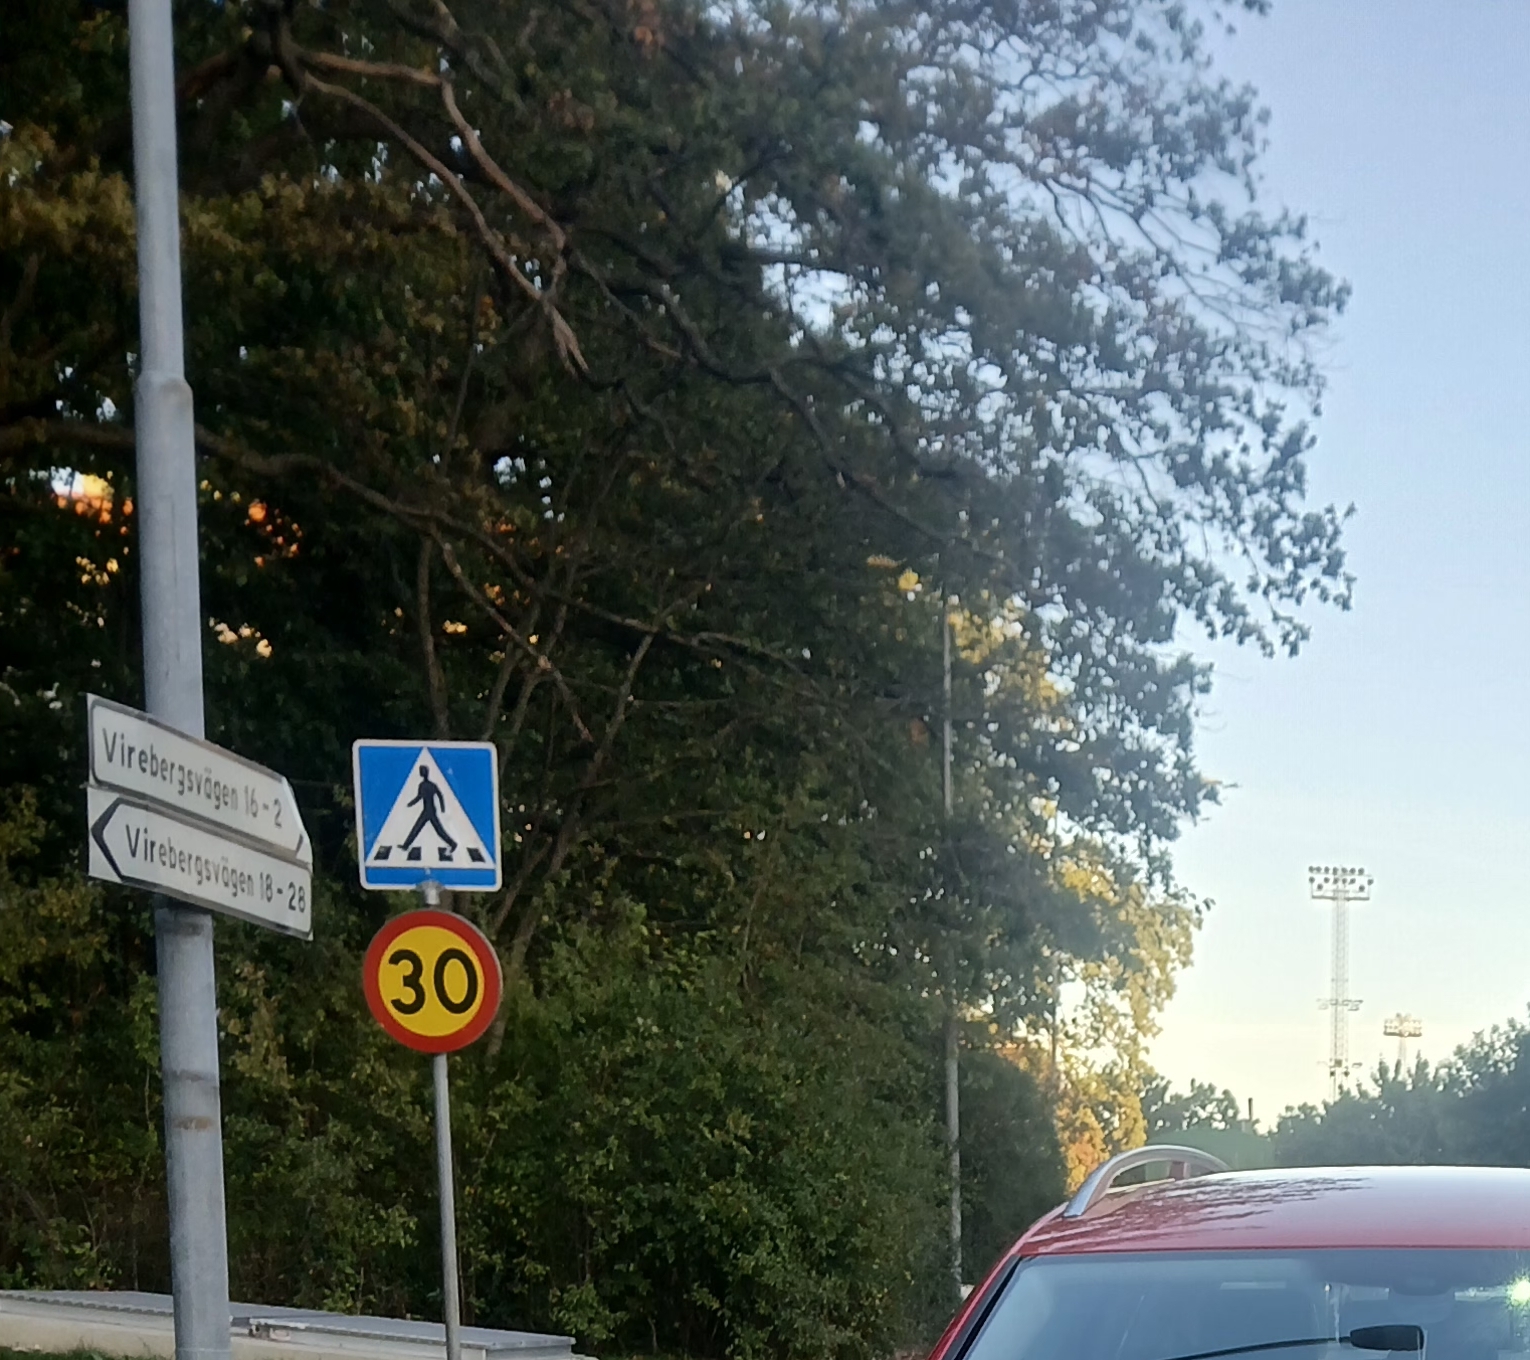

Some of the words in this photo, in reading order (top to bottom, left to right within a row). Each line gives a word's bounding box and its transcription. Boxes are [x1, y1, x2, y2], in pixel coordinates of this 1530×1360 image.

[102, 728, 239, 811] Virebergsvägen
[125, 824, 254, 898] Virebergsvägen
[387, 948, 479, 1015] 30
